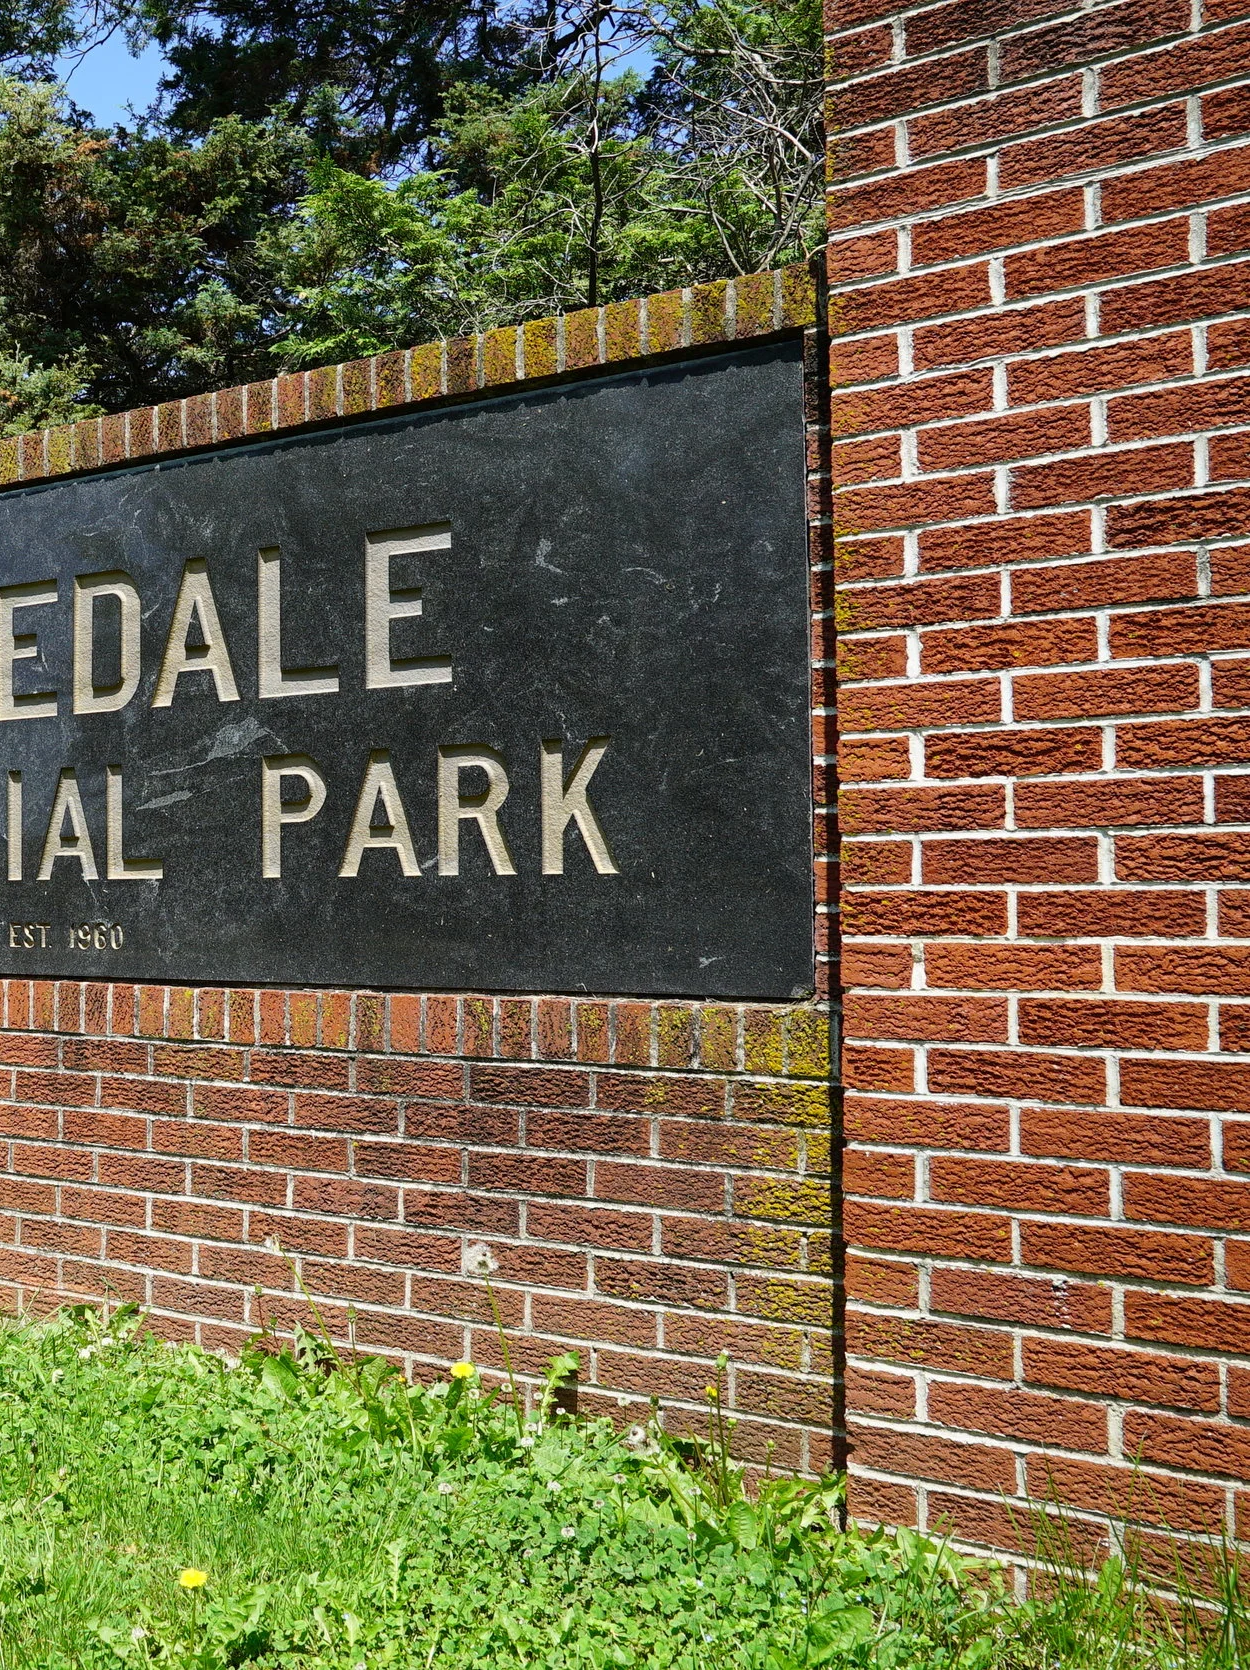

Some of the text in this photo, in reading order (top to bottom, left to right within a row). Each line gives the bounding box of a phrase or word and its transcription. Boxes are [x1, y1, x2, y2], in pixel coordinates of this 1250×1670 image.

[261, 736, 620, 879] PARK
[9, 922, 124, 950] EST. 1960
